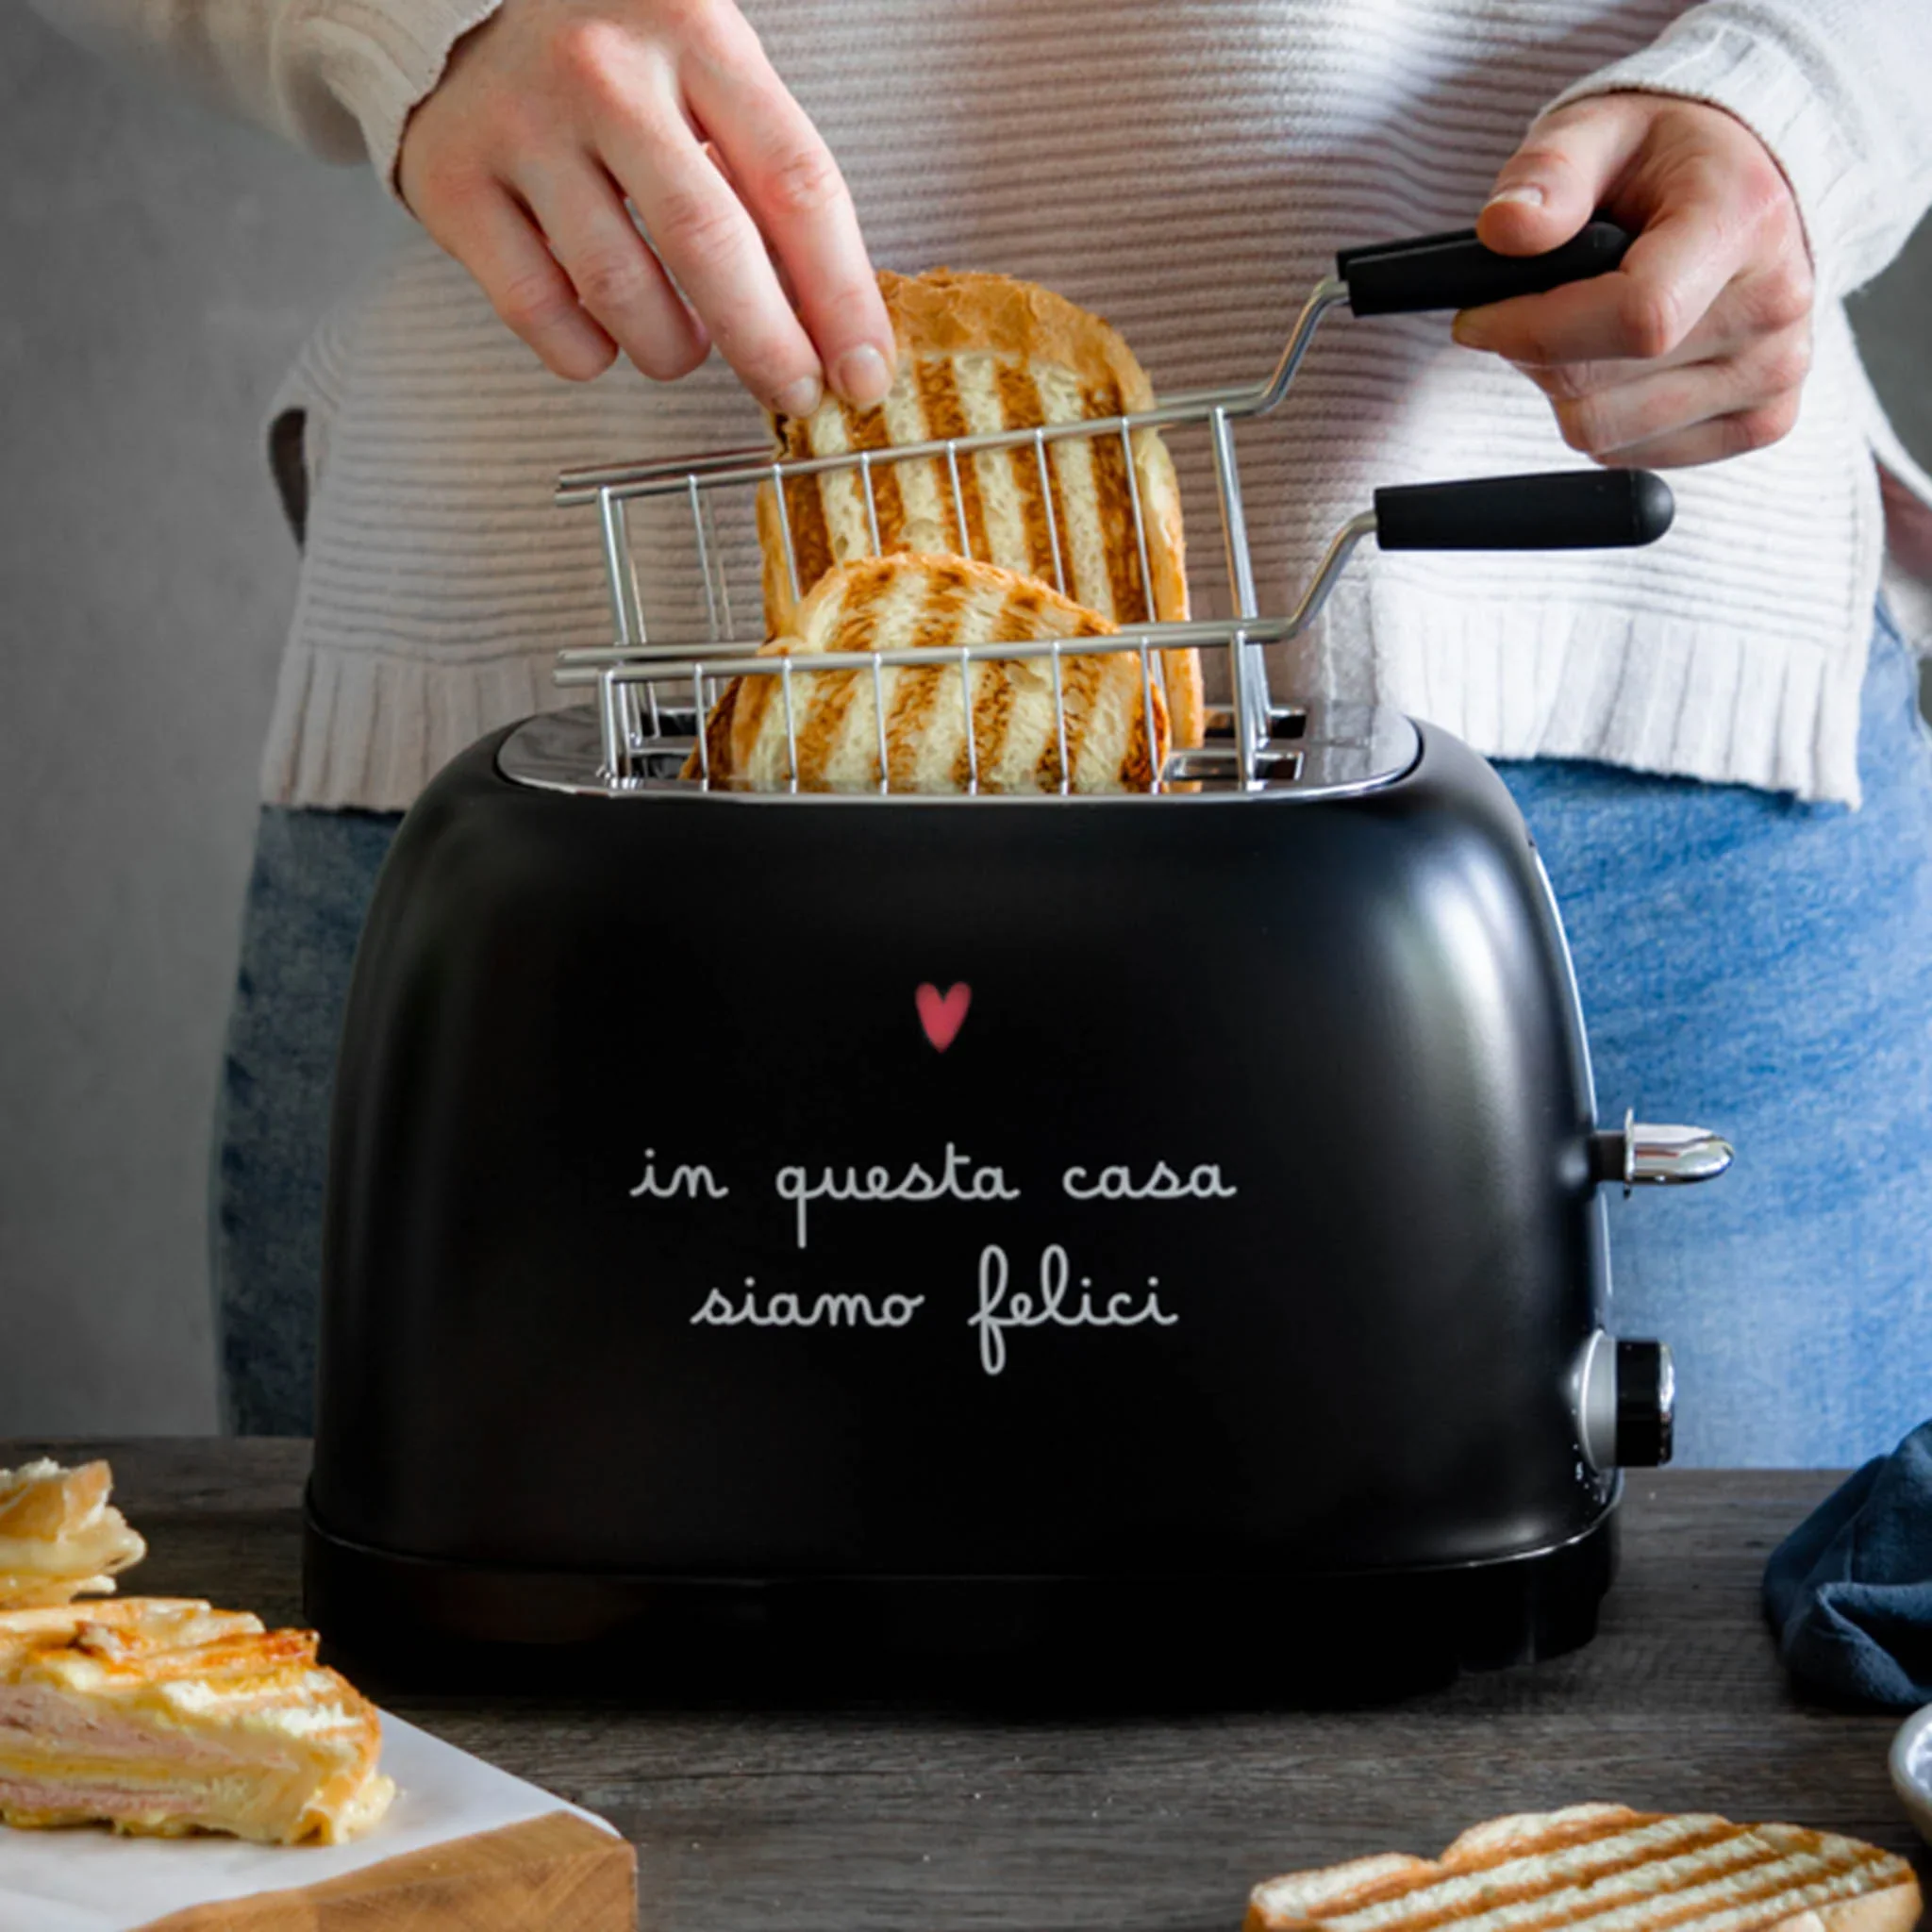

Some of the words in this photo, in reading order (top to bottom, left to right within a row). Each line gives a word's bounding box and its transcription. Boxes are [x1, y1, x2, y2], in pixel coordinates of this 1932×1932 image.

[629, 1148, 729, 1198] in
[776, 1142, 1021, 1249] questa
[1062, 1160, 1238, 1199] casa
[690, 1277, 925, 1326] siamo
[968, 1244, 1178, 1375] felici
